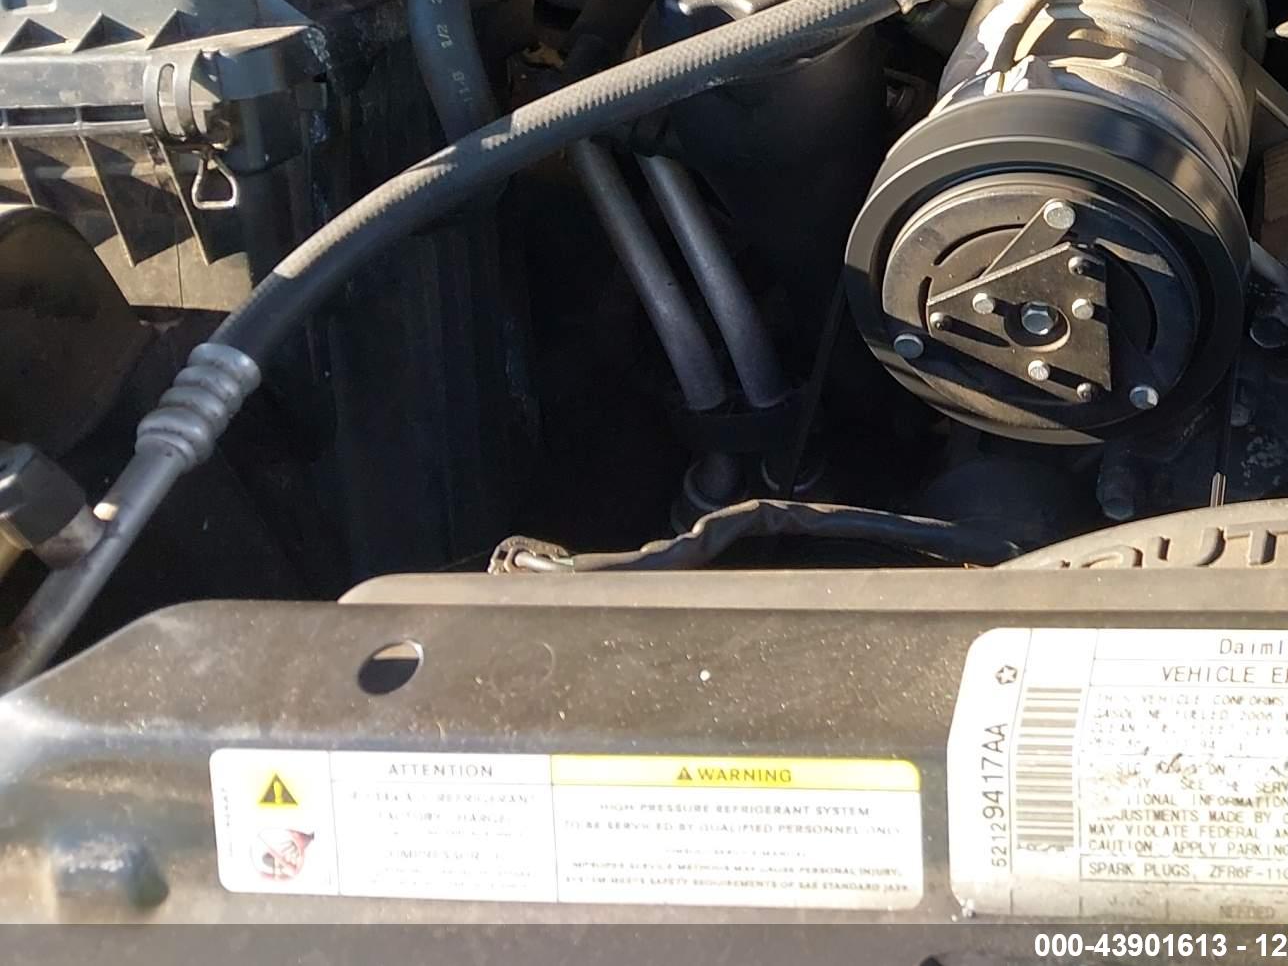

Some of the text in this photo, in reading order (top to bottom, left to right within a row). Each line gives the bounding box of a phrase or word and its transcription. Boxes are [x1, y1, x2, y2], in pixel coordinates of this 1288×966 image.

[1161, 666, 1259, 683] VEHICLE
[389, 763, 793, 784] ATTENTION WARNING
[981, 723, 1008, 867] 52129417AA
[640, 803, 710, 814] PRESSURE
[716, 804, 809, 815] REFRIGERANT
[815, 806, 871, 817] SYSTEM
[1095, 809, 1200, 822] JUSTMENTS
[1209, 810, 1244, 823] MADE
[1254, 811, 1273, 824] BY
[778, 823, 859, 836] PERSONNEL
[1088, 823, 1115, 836] MAY
[1127, 824, 1190, 837] VIOLATE
[1199, 825, 1260, 839] FEDERAL
[1172, 842, 1217, 856] APPLY
[1088, 862, 1136, 876] SPARK
